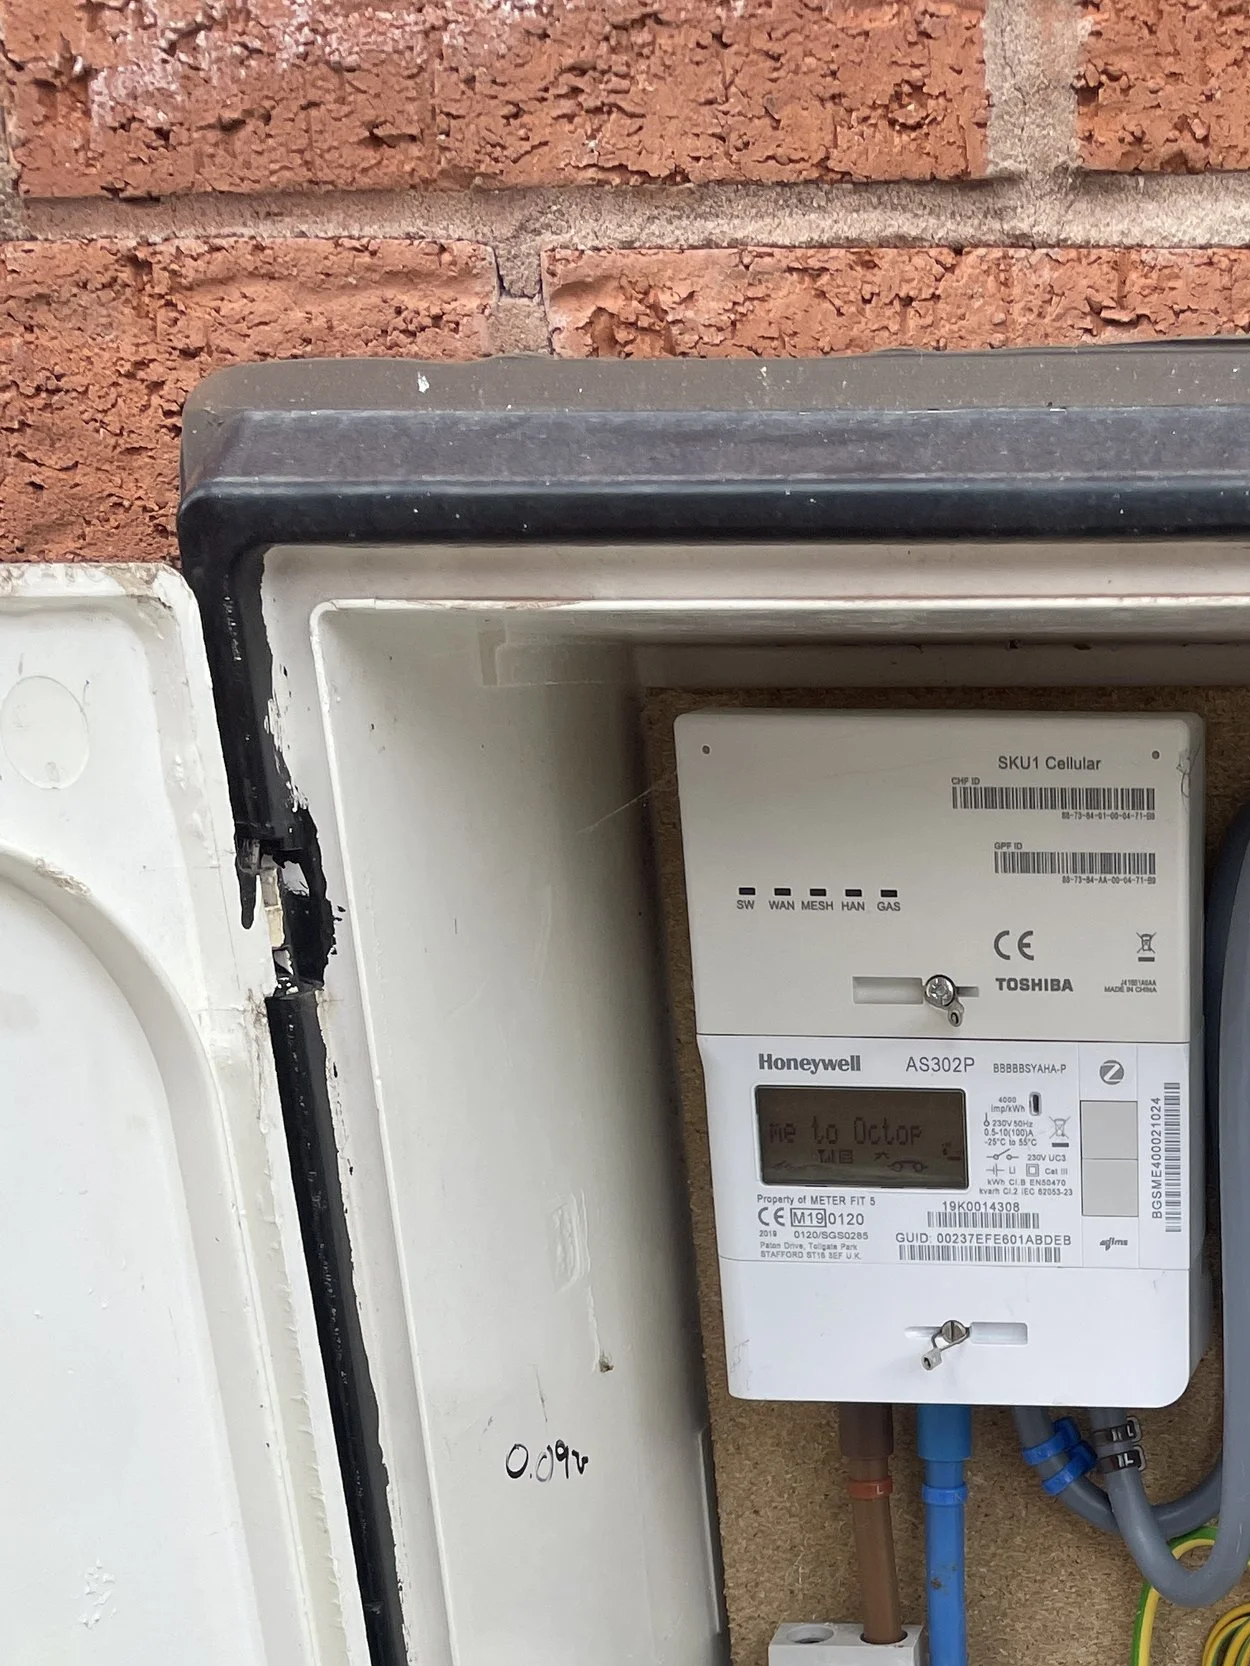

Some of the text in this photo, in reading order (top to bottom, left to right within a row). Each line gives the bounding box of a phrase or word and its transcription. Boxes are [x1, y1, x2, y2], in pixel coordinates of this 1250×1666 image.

[998, 756, 1102, 770] SKU1 Cellular
[971, 777, 980, 786] ID
[994, 842, 1023, 850] GPF ID
[736, 900, 901, 912] SW WAN MESH HAN GAS
[995, 977, 1074, 992] TOSHIBA
[758, 1053, 861, 1075] Honeywell
[905, 1056, 976, 1073] AS302P
[992, 1119, 1034, 1128] 230V 50Hz
[811, 1115, 838, 1144] to
[854, 1116, 923, 1146] Octop
[984, 1128, 1034, 1138] 0.5-10(100)A
[1008, 1138, 1016, 1146] to
[1151, 1097, 1163, 1220] BGSME400021024
[757, 1194, 876, 1206] Property of METER FIT 5
[942, 1201, 1020, 1212] 19K0014308
[792, 1210, 825, 1225] M19
[827, 1212, 865, 1226] 0120
[793, 1230, 869, 1240] 0120/SGS0285
[895, 1232, 932, 1244] GUID:
[760, 1241, 781, 1249] Paton
[808, 1242, 838, 1251] Tollgate
[840, 1243, 858, 1251] Park
[760, 1250, 804, 1259] STAFFORD
